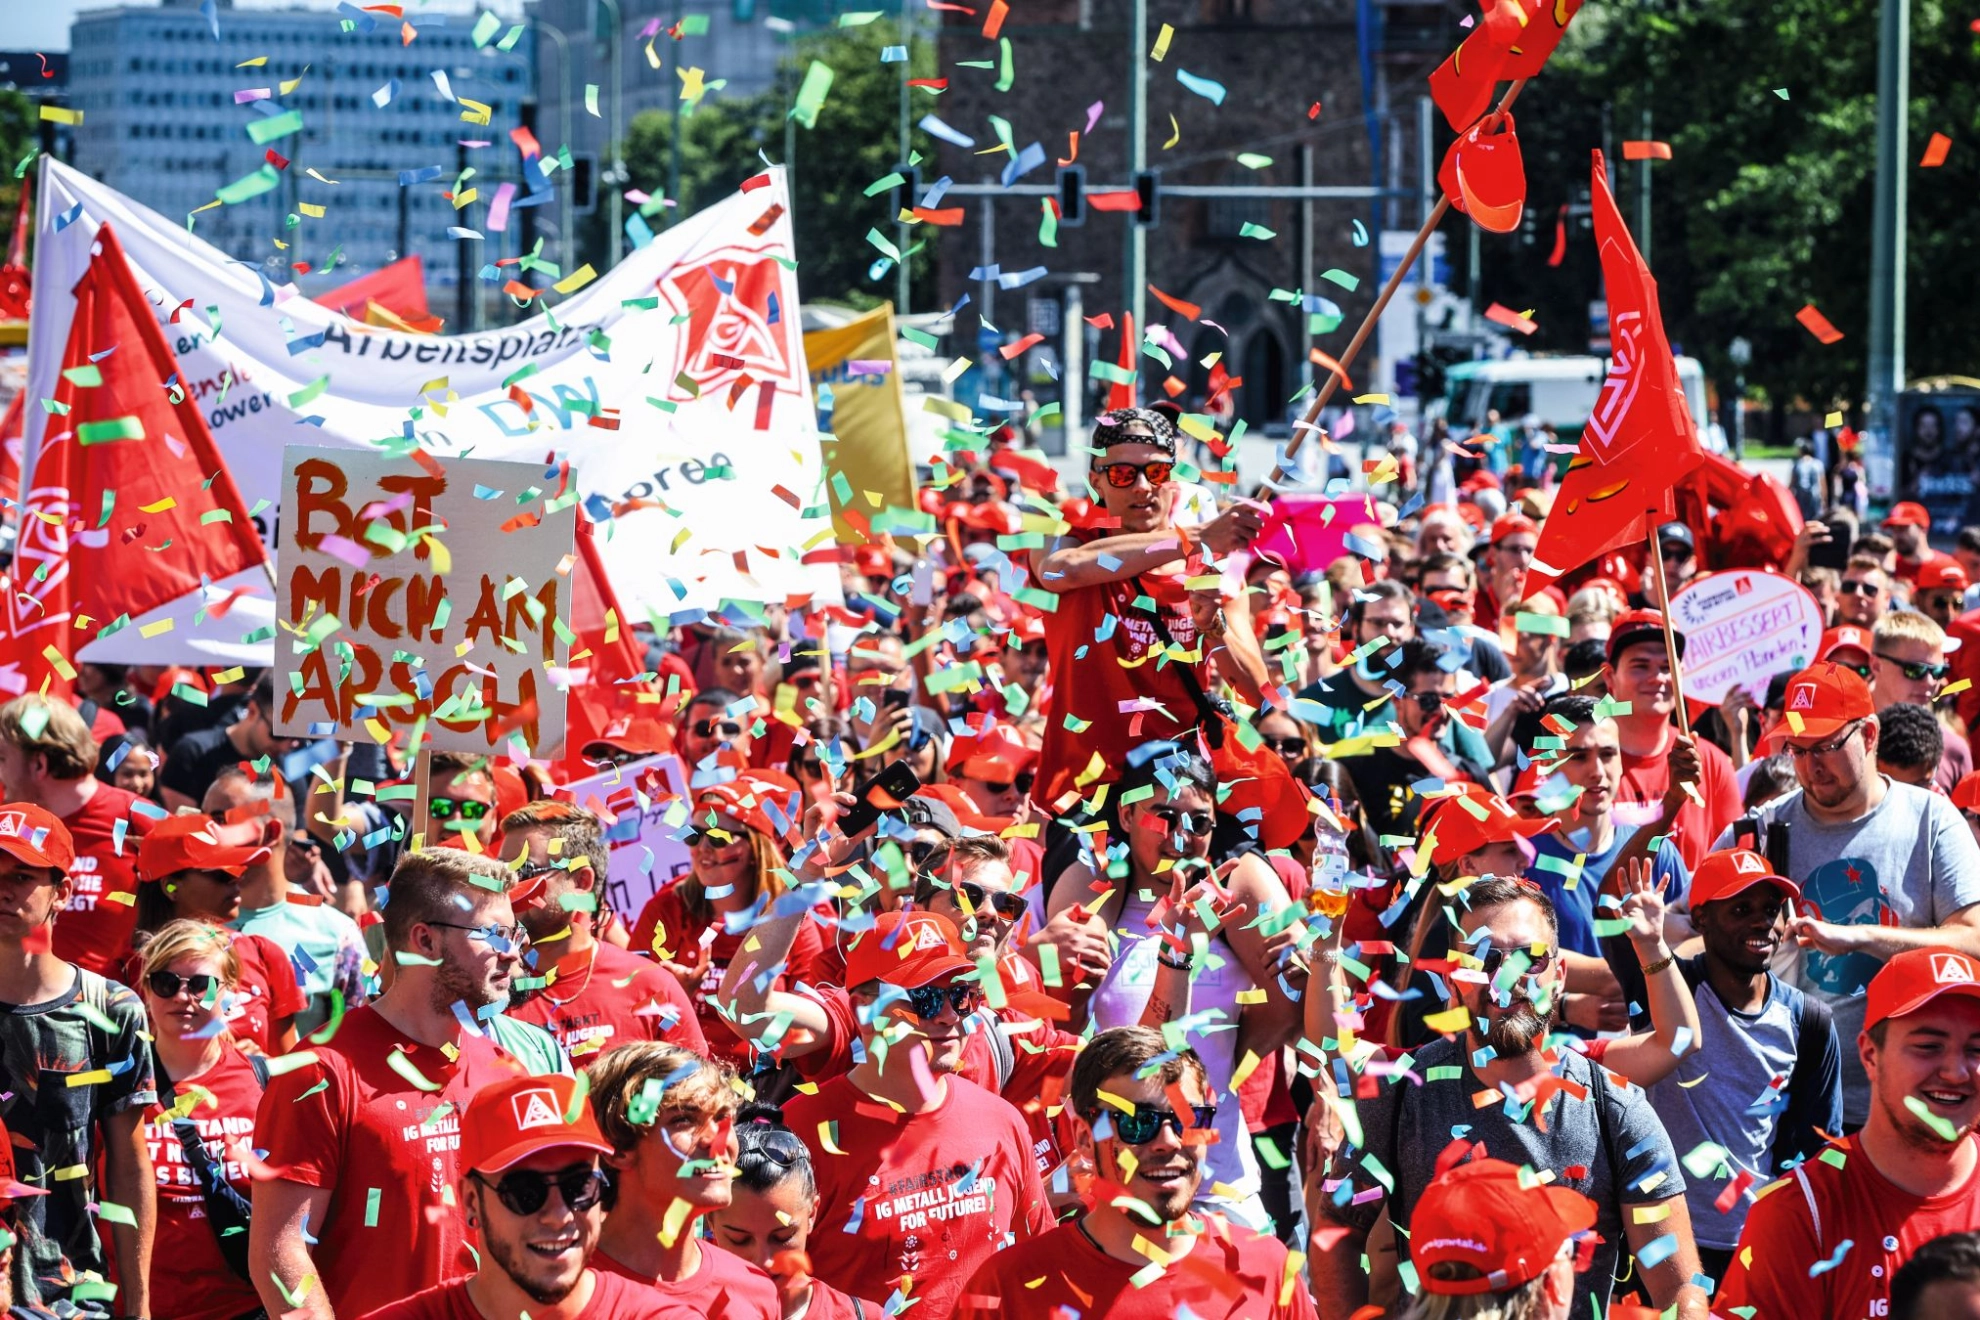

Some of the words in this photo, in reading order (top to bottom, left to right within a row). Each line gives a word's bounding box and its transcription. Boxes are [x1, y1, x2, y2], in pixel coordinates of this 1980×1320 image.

[290, 565, 449, 644] MICH
[464, 574, 558, 661] AM
[281, 643, 540, 752] ARSCH
[403, 1125, 420, 1142] IG
[426, 1136, 447, 1154] FOR
[874, 1201, 893, 1220] IG
[893, 1187, 947, 1215] METALL
[900, 1211, 927, 1232] FOR
[927, 1195, 987, 1222] FUTURE!
[1869, 1298, 1889, 1318] IG
